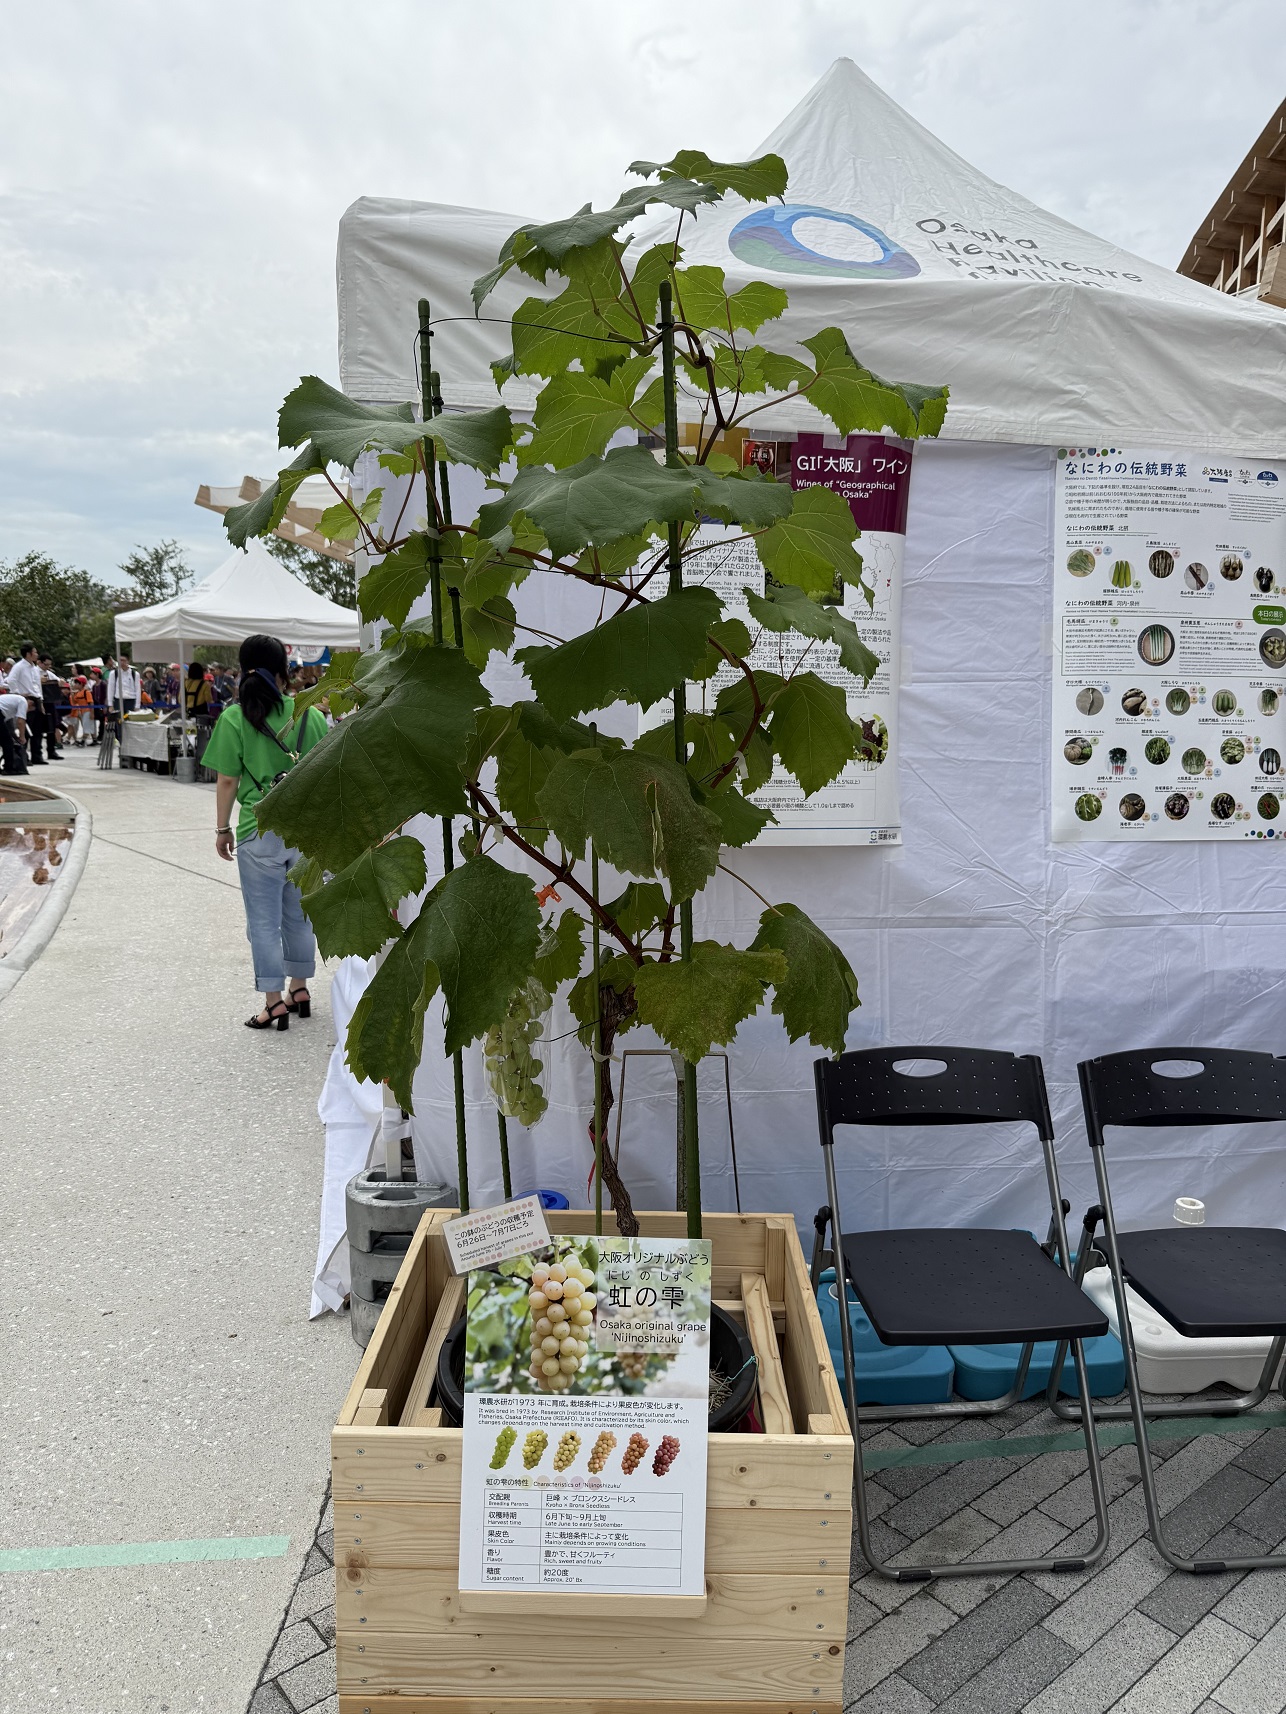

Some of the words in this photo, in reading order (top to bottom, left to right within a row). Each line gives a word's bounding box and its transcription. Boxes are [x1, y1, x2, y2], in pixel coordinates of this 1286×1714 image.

[916, 218, 1039, 249] Osaka
[931, 239, 1142, 283] Healthcare
[796, 456, 860, 474] GI「大阪」
[872, 458, 908, 475] ワイン
[1065, 461, 1188, 478] なにわの伝統野菜
[796, 479, 821, 488] Wines
[454, 1210, 534, 1241] この鉢のぶどうの収穫予定
[480, 1243, 495, 1252] harvest
[599, 1251, 709, 1266] 大阪オリジナルぶどう
[608, 1270, 630, 1281] にじ
[640, 1271, 651, 1280] の
[661, 1271, 694, 1282] しずく
[609, 1284, 684, 1309] 虹の雫
[600, 1320, 632, 1329] Osaka
[634, 1321, 674, 1332] original
[677, 1322, 706, 1333] grape
[612, 1333, 686, 1344] ‘Nijinoshizuku’
[479, 1398, 535, 1406] 環農水研が1973
[538, 1399, 684, 1410] 年に育成。栽培条件により果皮色が変化します。
[485, 1478, 529, 1487] 虹の雫の特性
[489, 1493, 511, 1501] 交配親
[571, 1495, 636, 1503] ブロンクスシードレス
[488, 1511, 517, 1520] 収穫時期
[488, 1530, 510, 1538] 果皮色
[545, 1531, 629, 1540] 主に栽培条件によって変化
[544, 1550, 615, 1558] 豊かで、甘くフルーティ
[544, 1568, 569, 1576] 約20度
